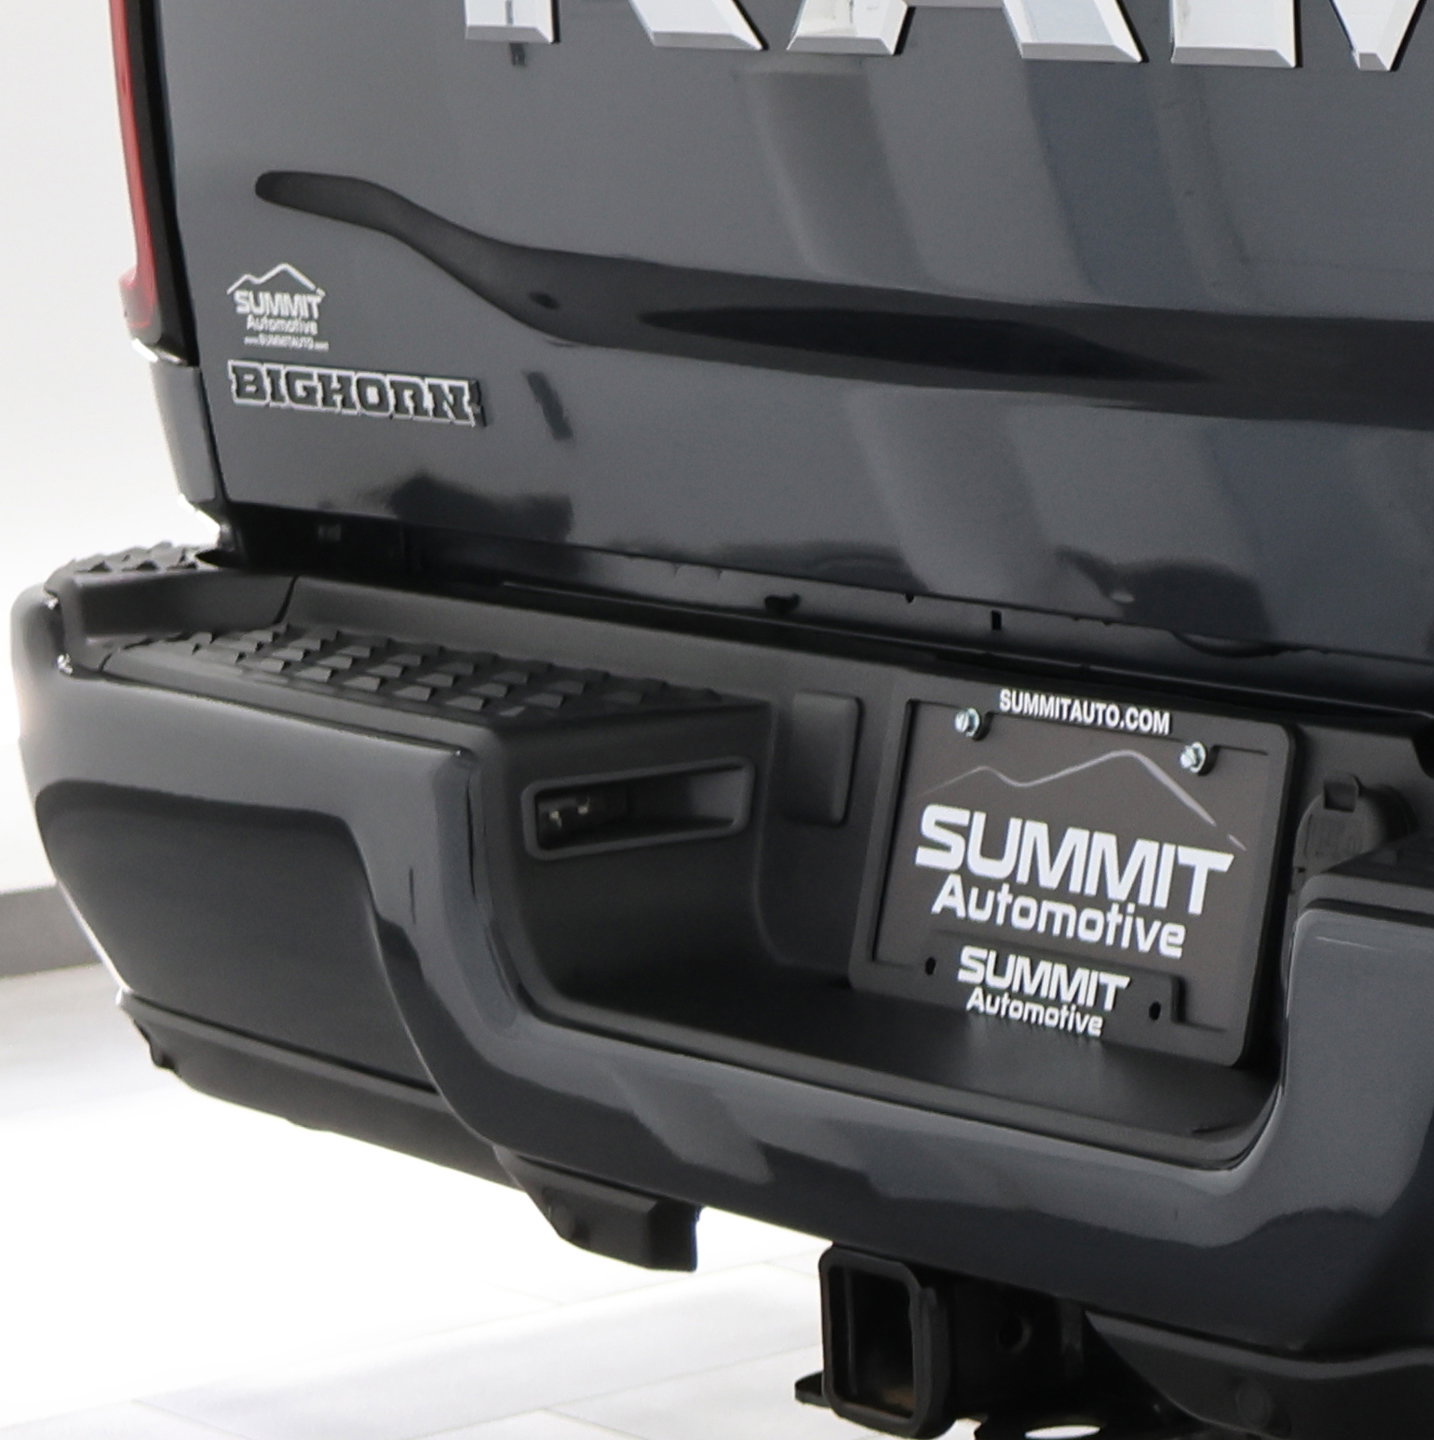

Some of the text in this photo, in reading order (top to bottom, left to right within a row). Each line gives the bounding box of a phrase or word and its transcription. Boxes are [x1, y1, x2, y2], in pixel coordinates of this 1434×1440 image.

[233, 289, 322, 320] SUMMIT
[246, 313, 318, 335] Automotive
[227, 360, 482, 427] BIGHORN
[1000, 688, 1171, 735] SUMMITAUTO.COM
[915, 804, 1235, 915] SUMMIT
[931, 873, 1187, 959] Automotive
[957, 945, 1131, 1012] SUMMIT
[966, 986, 1104, 1038] Automotive
